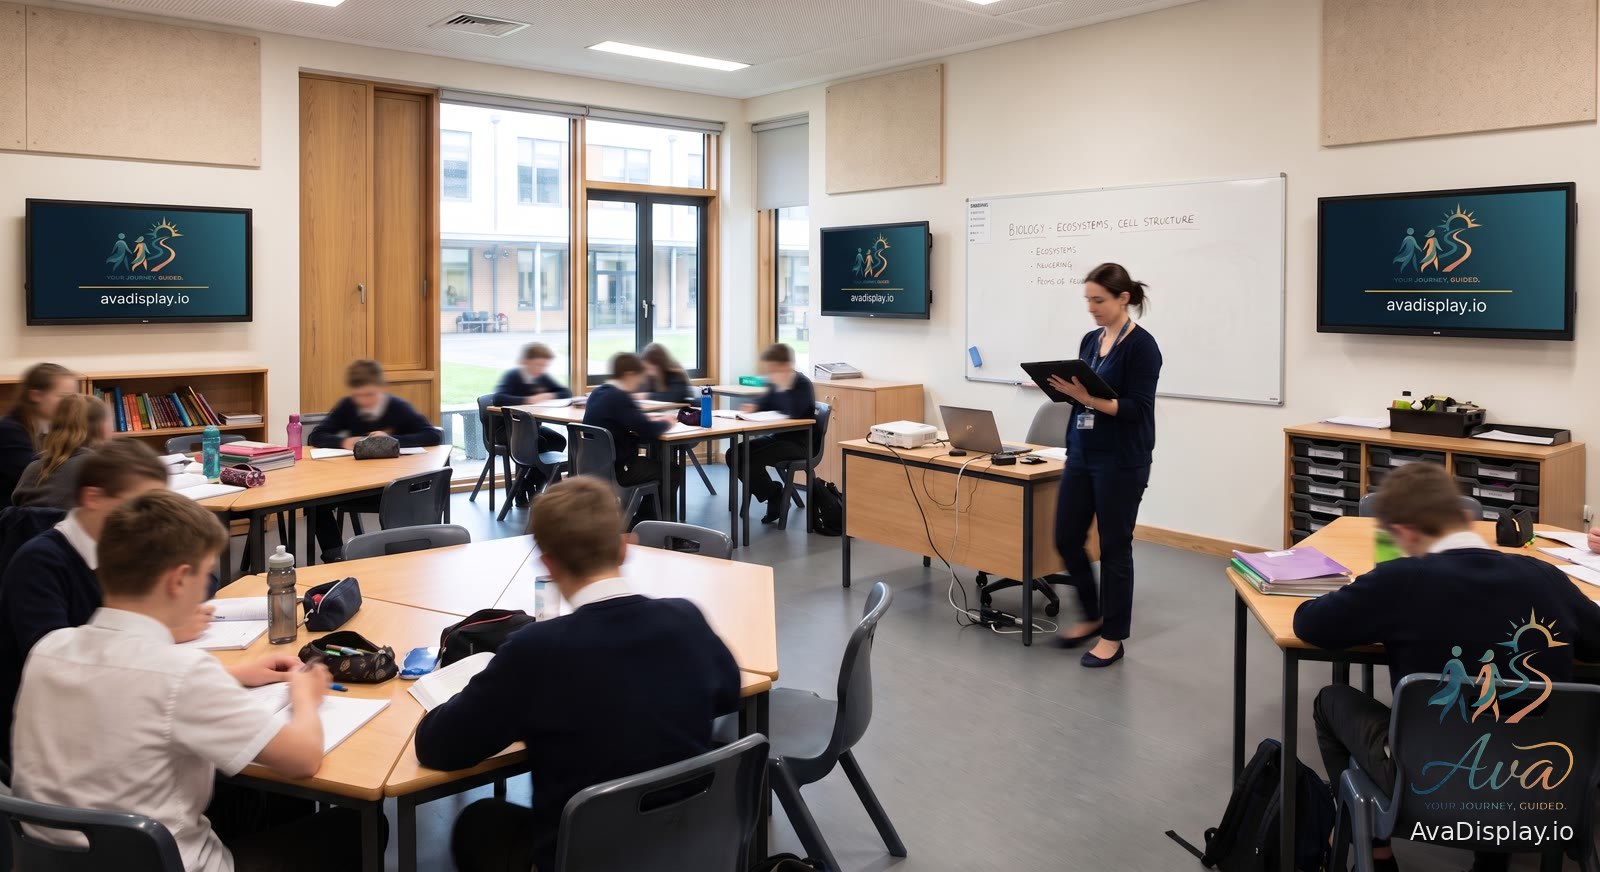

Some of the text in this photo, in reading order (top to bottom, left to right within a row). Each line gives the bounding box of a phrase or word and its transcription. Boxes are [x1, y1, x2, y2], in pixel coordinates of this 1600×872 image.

[1008, 223, 1045, 237] BIOLOGY
[1117, 218, 1139, 229] CELL
[1143, 214, 1195, 227] STRUCTURE
[1036, 246, 1077, 256] ECOSYSTEMS
[100, 293, 190, 307] avadisplay.io
[850, 293, 895, 304] avadisplay.io
[1386, 298, 1487, 316] avadisplay.io
